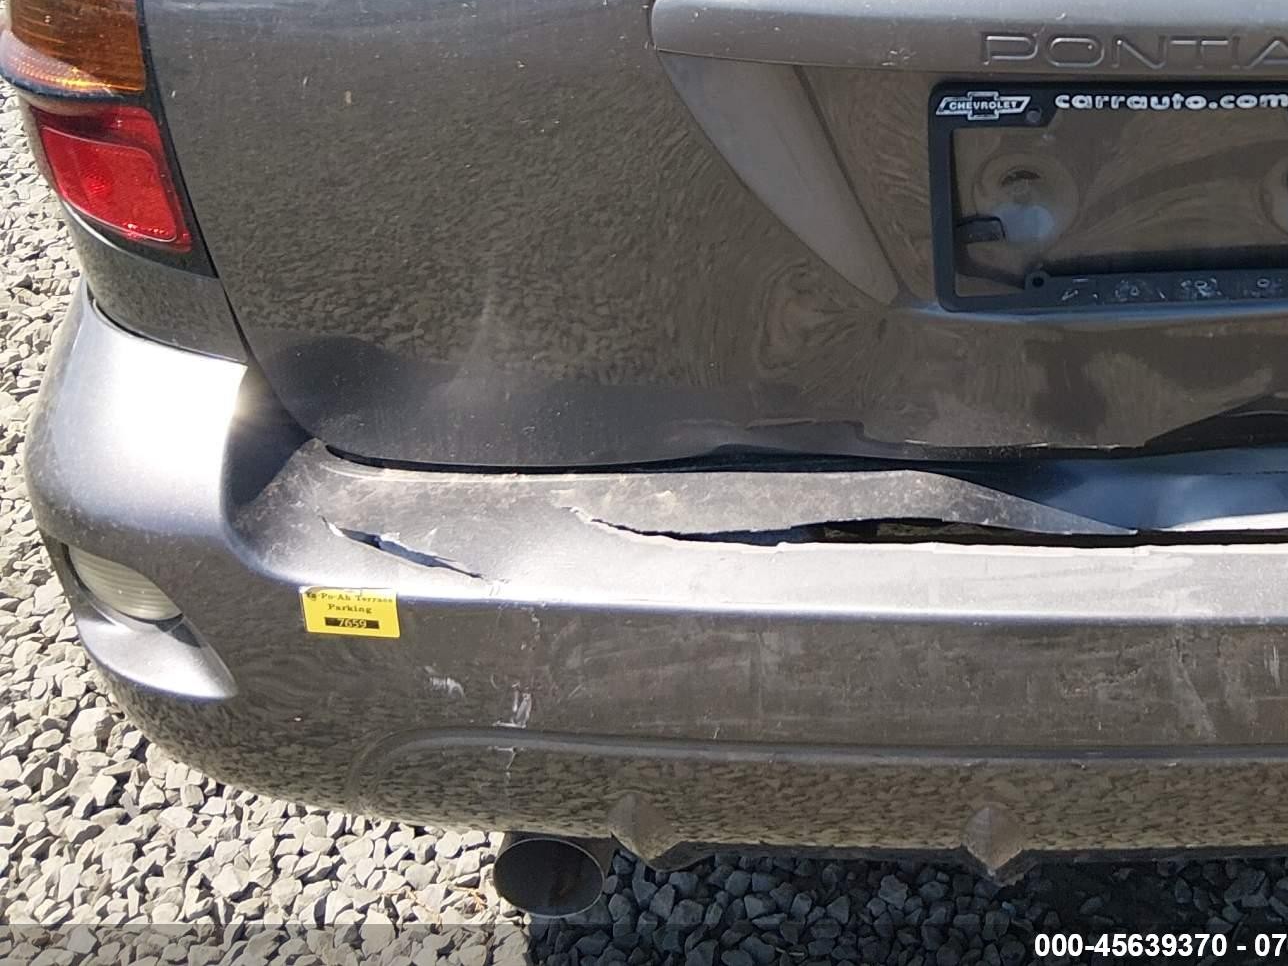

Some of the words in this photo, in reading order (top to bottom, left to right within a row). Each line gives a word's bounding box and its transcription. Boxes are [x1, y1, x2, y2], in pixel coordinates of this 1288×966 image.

[948, 99, 1018, 111] CHEVROLET
[1055, 92, 1288, 112] carrauto.com
[327, 603, 372, 614] Parking
[338, 618, 367, 628] 7659
